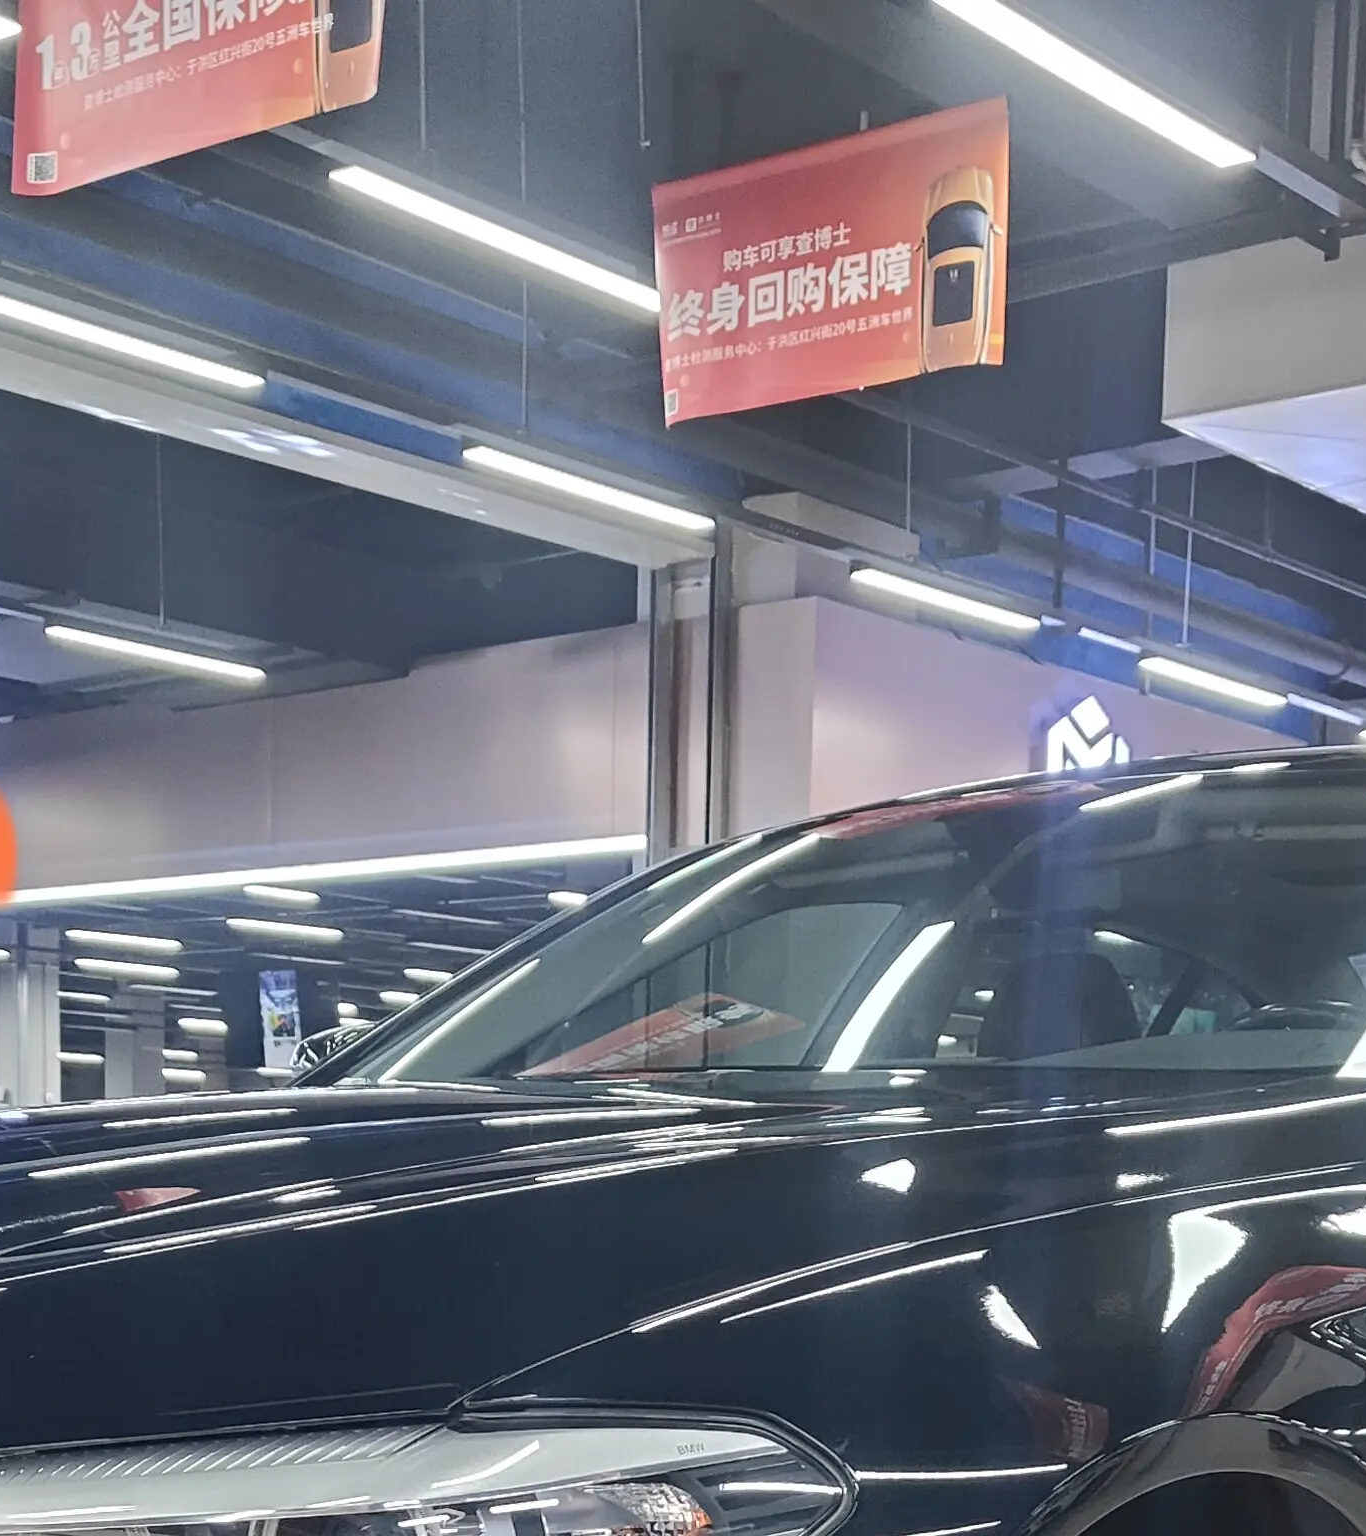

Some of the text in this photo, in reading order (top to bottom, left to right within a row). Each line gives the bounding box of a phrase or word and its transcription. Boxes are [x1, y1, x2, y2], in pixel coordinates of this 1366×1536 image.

[722, 222, 852, 274] 购车可享查博士
[665, 241, 914, 343] 终身回购保障
[677, 1442, 704, 1455] BMW
